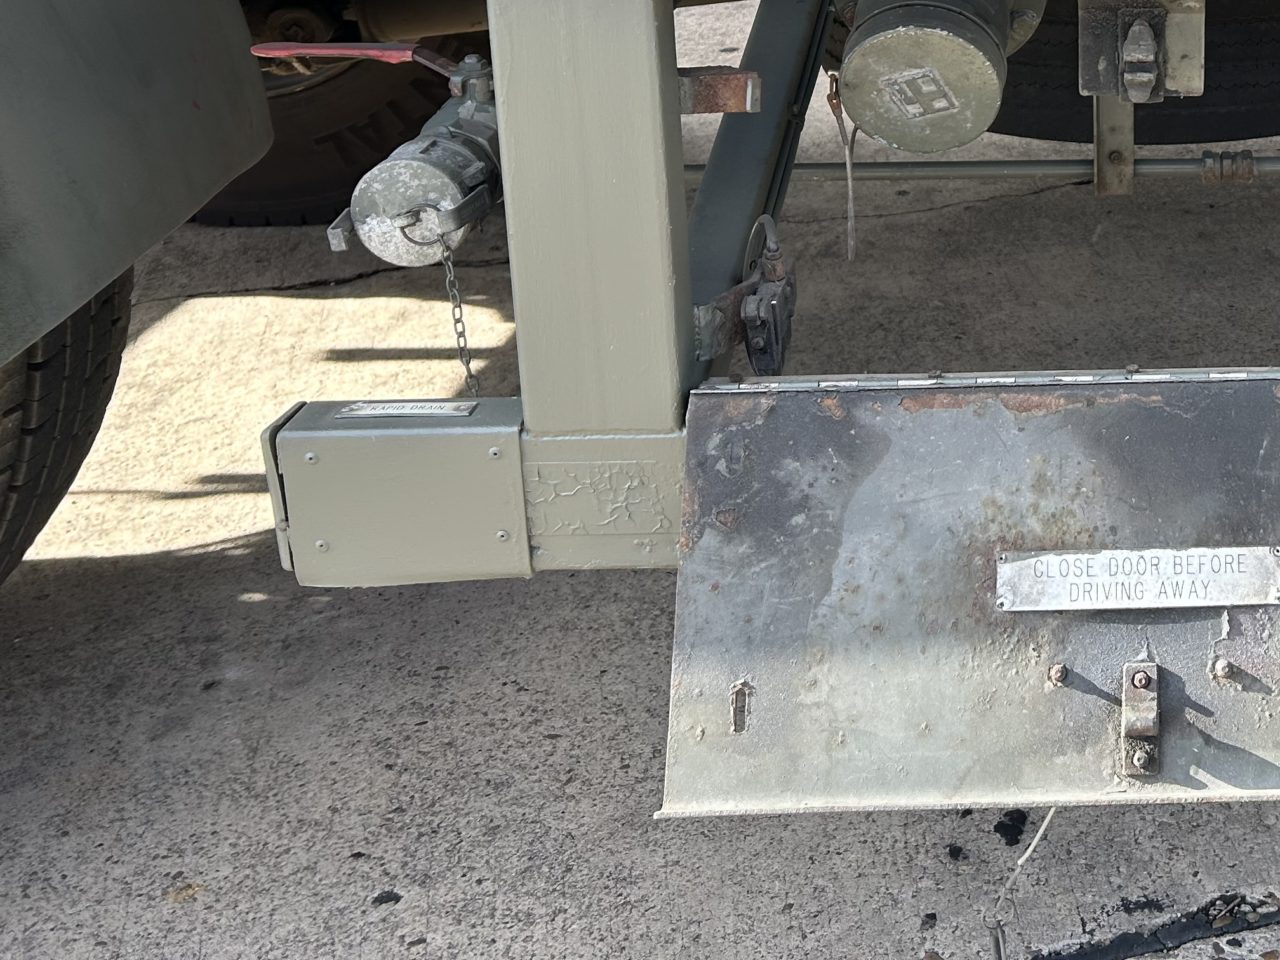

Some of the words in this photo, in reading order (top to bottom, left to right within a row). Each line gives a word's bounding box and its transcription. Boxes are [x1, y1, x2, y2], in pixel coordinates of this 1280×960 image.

[1033, 558, 1096, 579] CLOSE
[1108, 555, 1161, 577] DOOR
[1173, 553, 1247, 575] BEFORE
[1069, 581, 1145, 603] DRIVING
[1158, 579, 1211, 601] AWAY
